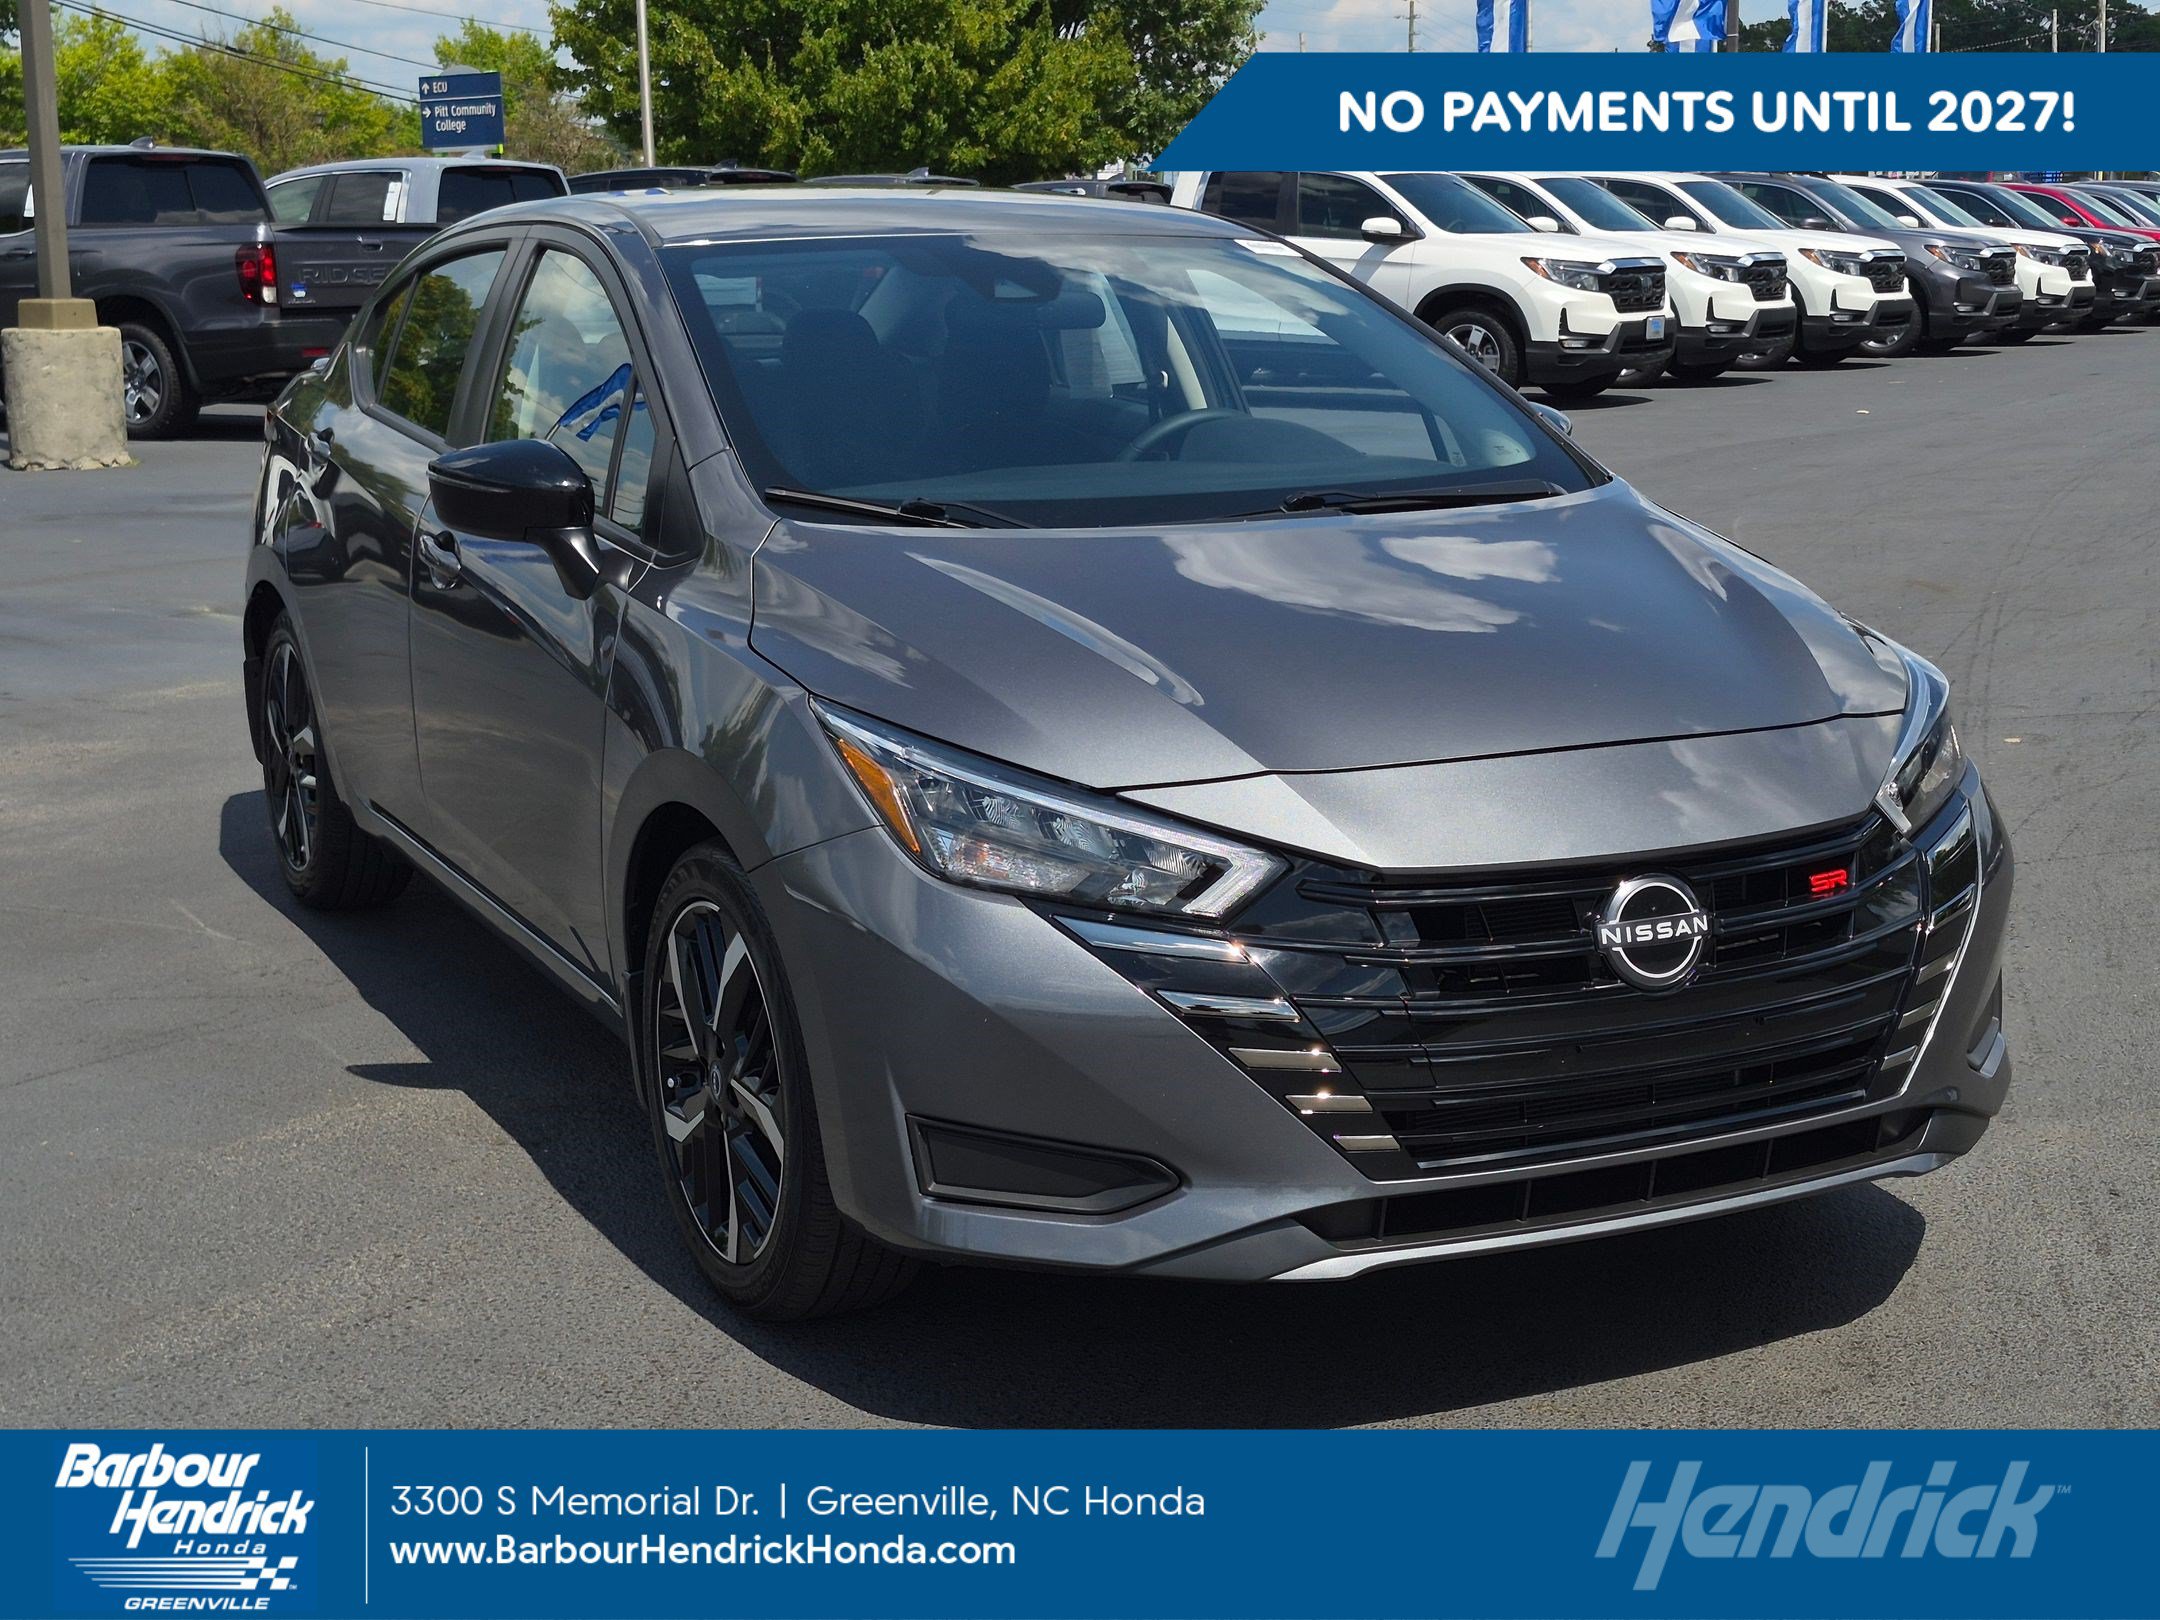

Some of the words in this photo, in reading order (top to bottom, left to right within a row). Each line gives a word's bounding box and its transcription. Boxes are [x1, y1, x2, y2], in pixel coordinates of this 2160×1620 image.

[432, 82, 448, 94] ECU
[434, 105, 449, 118] Pitt
[451, 102, 496, 117] Community
[435, 120, 467, 133] College
[300, 267, 388, 284] RIDGE
[1810, 868, 1848, 892] SR
[1600, 915, 1709, 945] NISSAN
